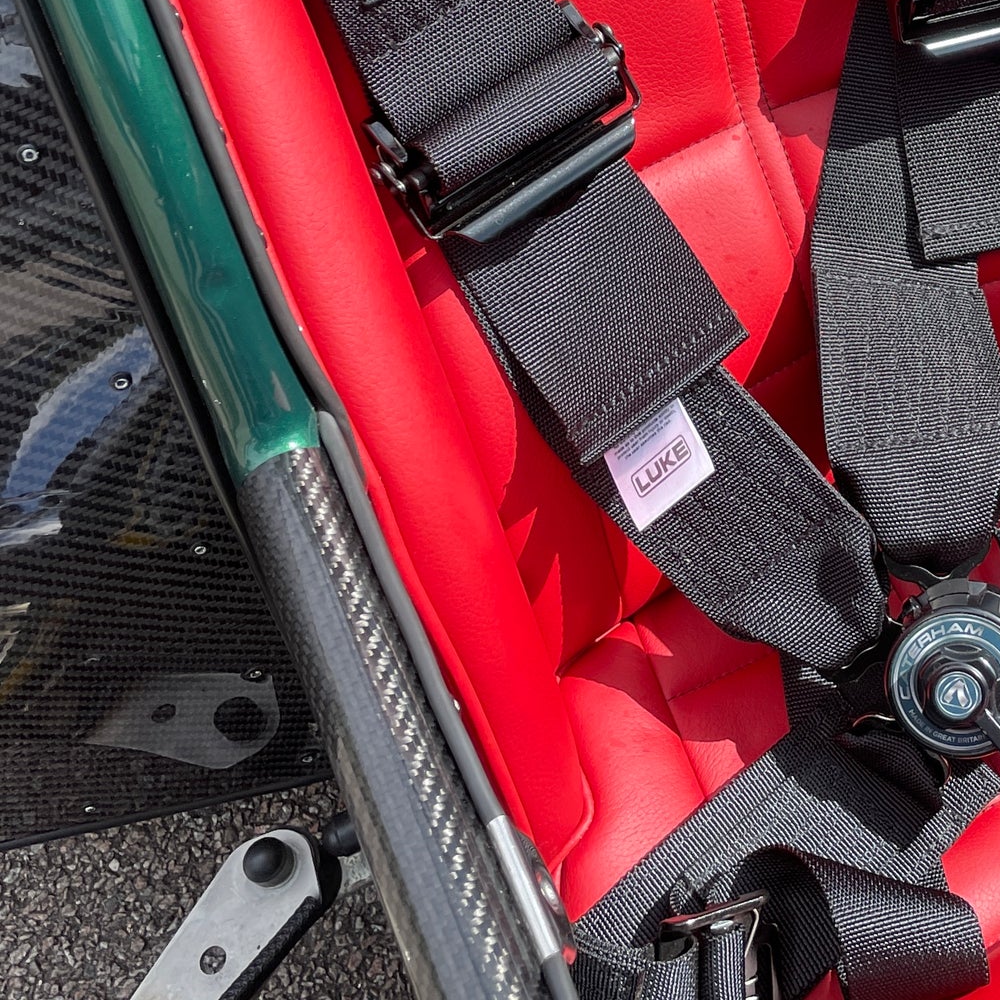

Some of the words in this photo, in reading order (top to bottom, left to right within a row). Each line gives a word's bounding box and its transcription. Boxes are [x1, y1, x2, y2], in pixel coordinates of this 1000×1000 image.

[635, 439, 689, 493] LUKE
[899, 622, 984, 700] CATERHAM
[932, 731, 957, 743] GREAT
